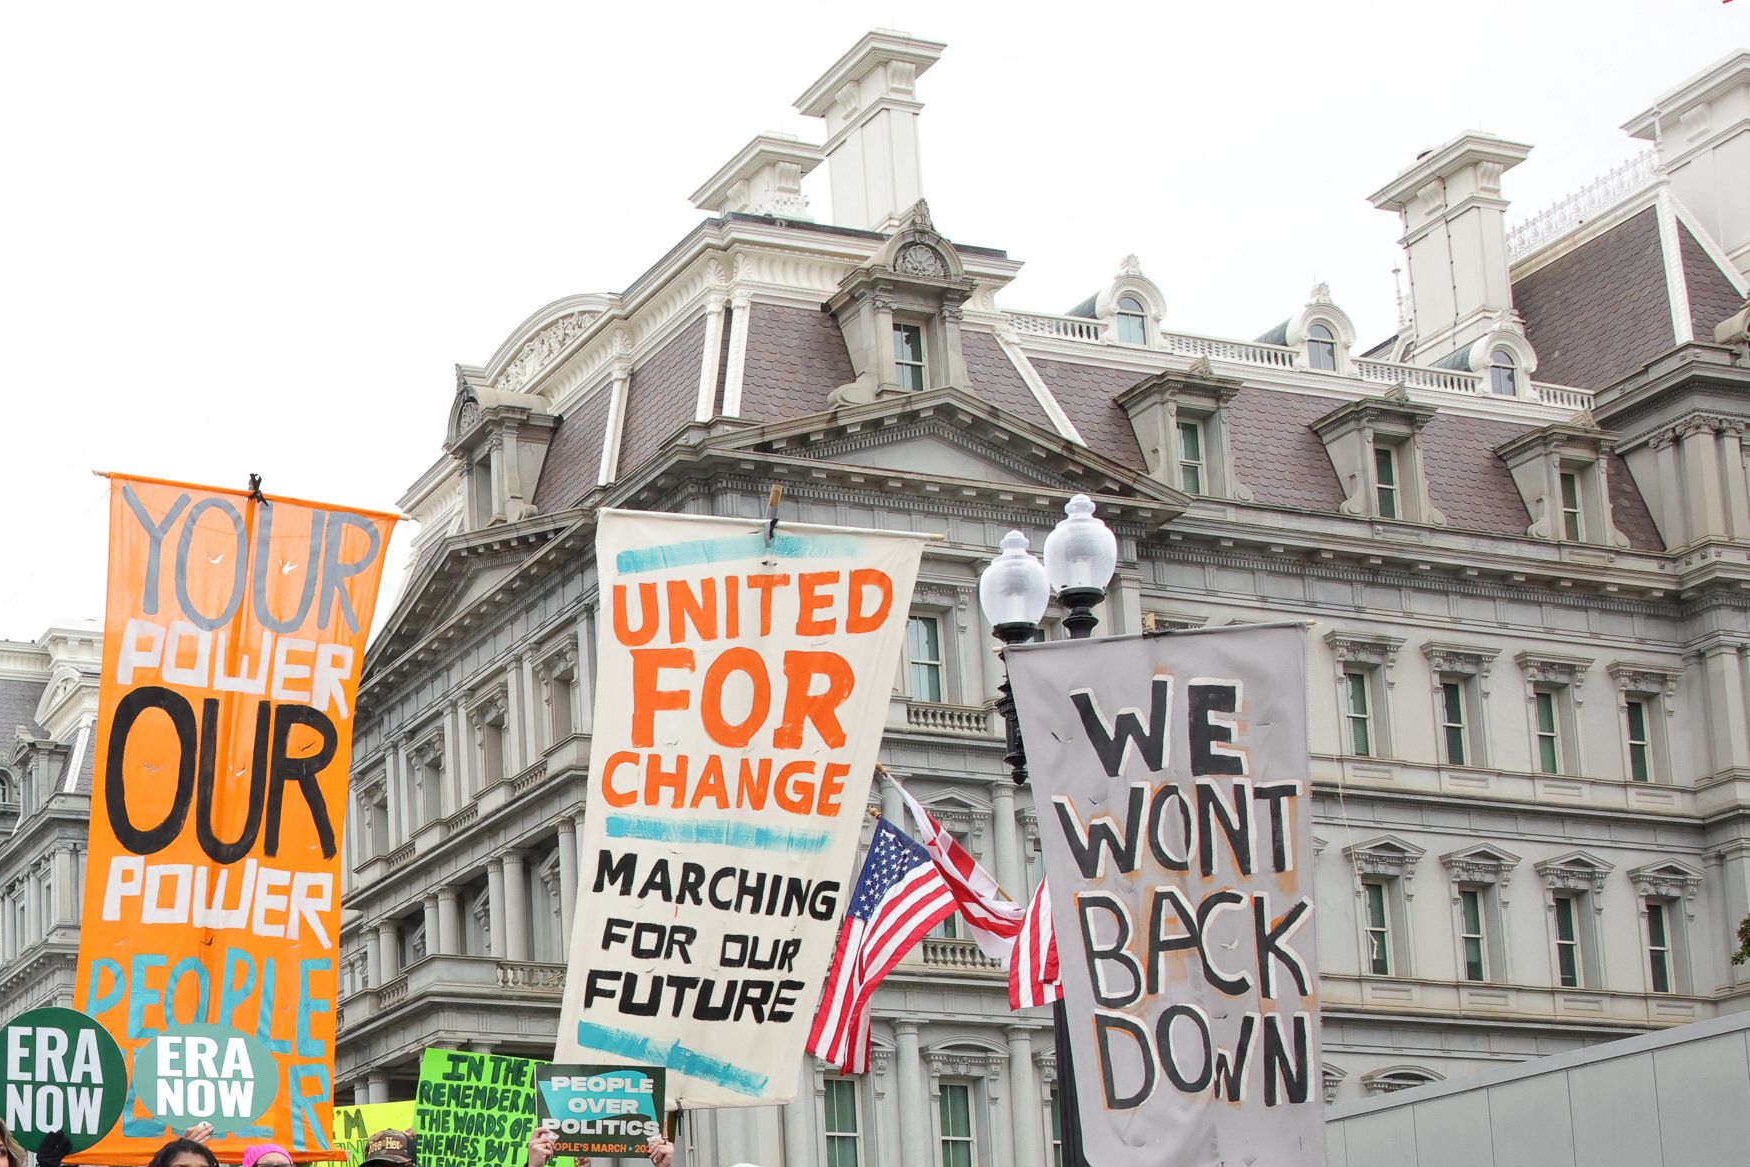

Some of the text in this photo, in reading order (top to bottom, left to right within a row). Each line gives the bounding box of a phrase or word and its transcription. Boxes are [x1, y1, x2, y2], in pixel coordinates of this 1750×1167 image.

[122, 484, 381, 634] YOUR
[612, 569, 893, 646] UNITED
[117, 618, 354, 719] POWER
[629, 647, 855, 750] FOR
[1070, 675, 1249, 777] WE
[105, 686, 337, 865] OUR
[601, 754, 851, 817] CHANGE
[1051, 779, 1303, 879] WONT
[102, 855, 333, 949] POWER
[592, 849, 840, 921] MARCHING
[601, 919, 801, 973] FOR OUR
[1075, 885, 1314, 1009] BACK
[85, 949, 331, 1057] PEOPLE
[584, 970, 805, 1024] FUTURE
[7, 1026, 104, 1085] ERA
[157, 1035, 255, 1079] ERA
[442, 1053, 485, 1082] IN
[489, 1055, 530, 1088] THE
[551, 1076, 654, 1094] PEOPLE
[1093, 1003, 1314, 1111] DOWN
[5, 1083, 104, 1136] NOW
[157, 1078, 255, 1118] NOW
[416, 1108, 533, 1142] THE WORDS OF
[418, 1080, 521, 1113] REMEMBER
[568, 1097, 639, 1114] OVER
[484, 1138, 523, 1165] BUT
[541, 1118, 660, 1136] POLITICS
[591, 1144, 627, 1153] MARCH
